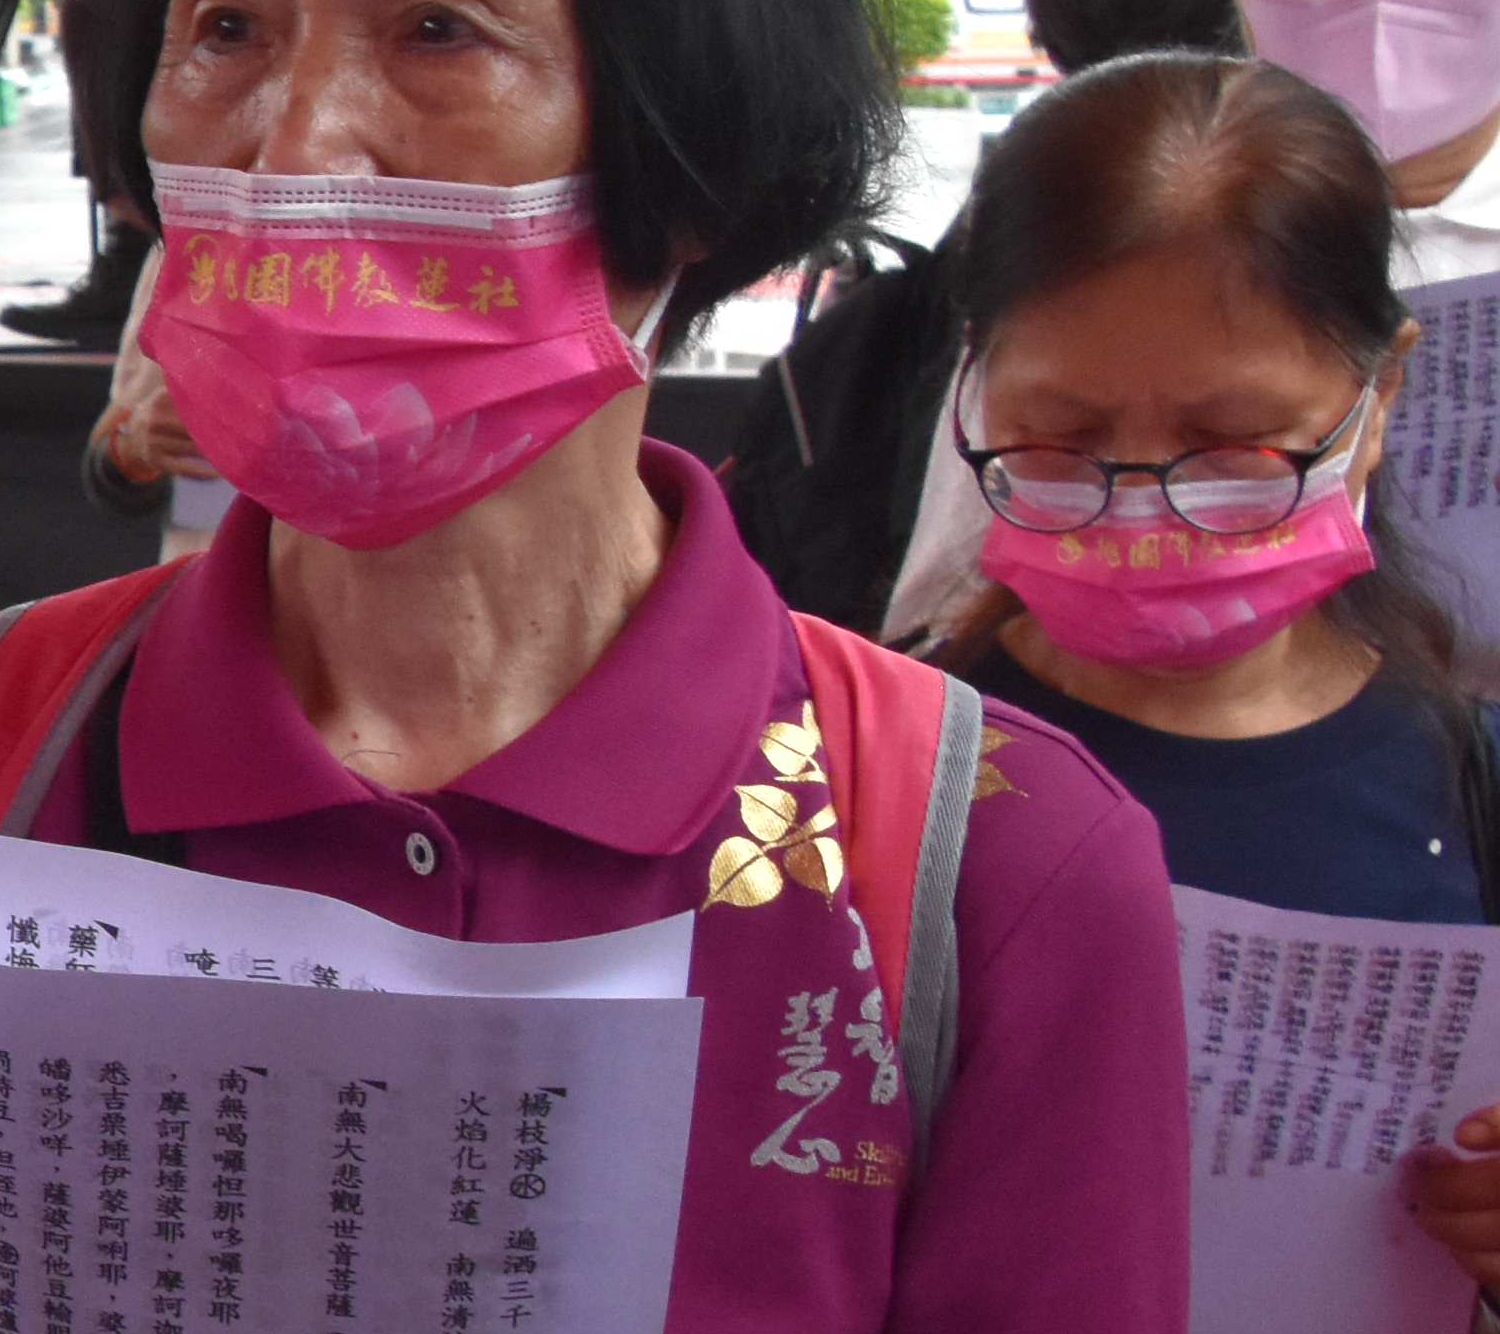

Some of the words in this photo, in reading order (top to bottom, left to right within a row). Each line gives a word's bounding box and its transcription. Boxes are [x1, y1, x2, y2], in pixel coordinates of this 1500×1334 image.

[326, 1082, 368, 1319] 南無大悲觀世音菩薩
[449, 1090, 490, 1226] 火焰化紅蓮
